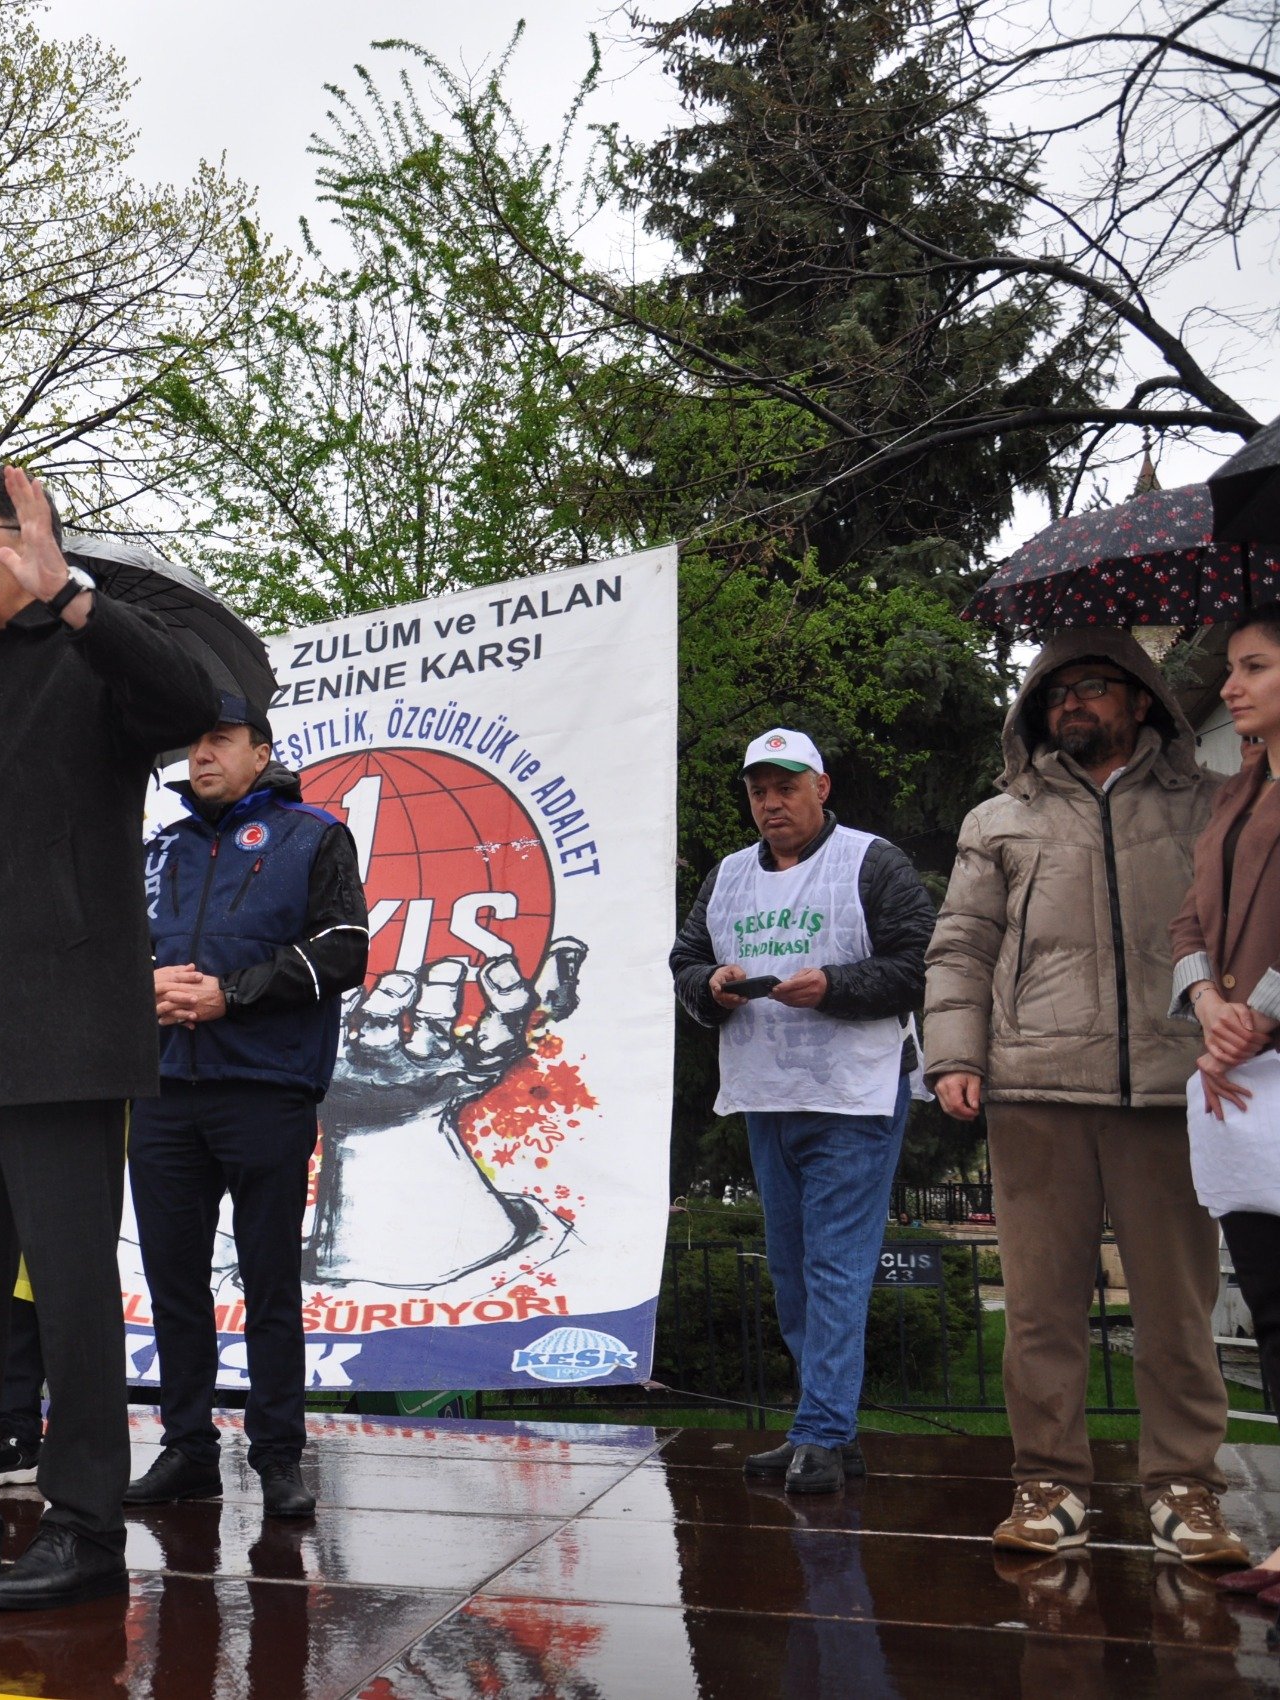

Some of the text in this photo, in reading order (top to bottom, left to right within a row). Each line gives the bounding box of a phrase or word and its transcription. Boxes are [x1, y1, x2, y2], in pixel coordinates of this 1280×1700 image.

[290, 575, 622, 669] ZULÜM ve TALAN
[421, 633, 542, 683] KARŞI
[387, 699, 520, 763] ÖZGÜRLÜK
[509, 749, 541, 782] ve
[531, 775, 600, 877] ADALET
[341, 775, 382, 885] 1
[734, 906, 824, 941] ŞEKER-İŞ
[738, 937, 810, 958] SENDİKASI
[885, 1269, 914, 1281] 43
[302, 1295, 569, 1333] SÜRÜYOR!
[516, 1349, 633, 1369] KESK
